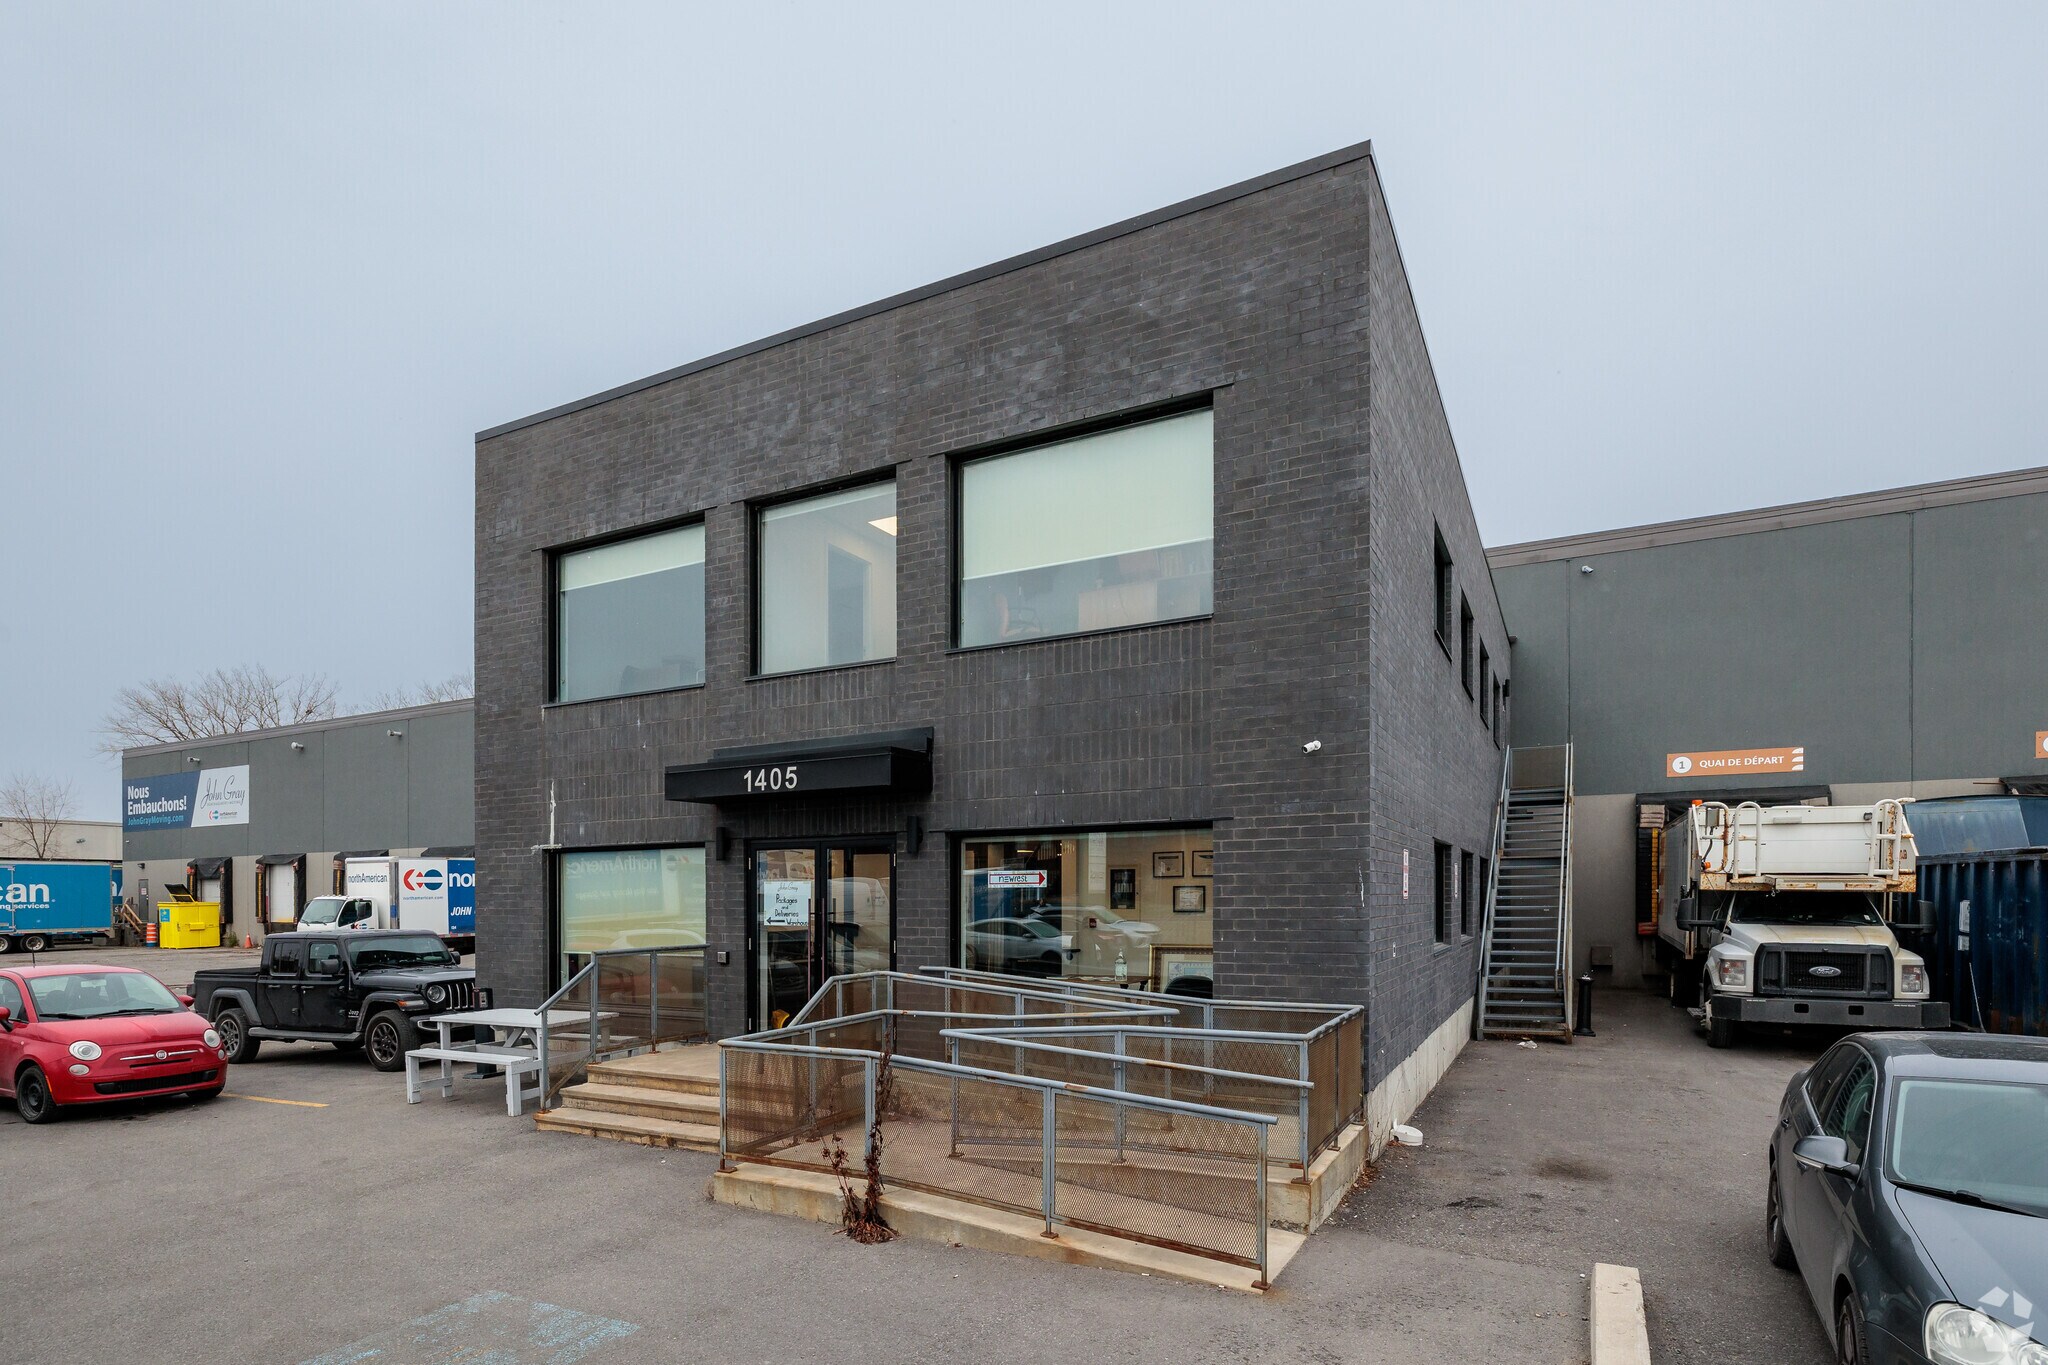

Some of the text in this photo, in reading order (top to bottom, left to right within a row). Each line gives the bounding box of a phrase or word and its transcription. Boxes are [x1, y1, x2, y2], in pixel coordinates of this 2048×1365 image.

[1678, 755, 1785, 770] 1 QUAI DE DÉPART
[743, 766, 798, 792] 1405
[127, 785, 150, 800] Nous
[200, 774, 246, 809] John Gray
[127, 795, 187, 816] Embauchons!
[127, 815, 184, 826] JohnGrayMoving.com
[348, 873, 388, 883] northAmerican
[775, 893, 798, 906] Packages
[450, 906, 473, 916] JOHN
[774, 908, 799, 918] Deliveries
